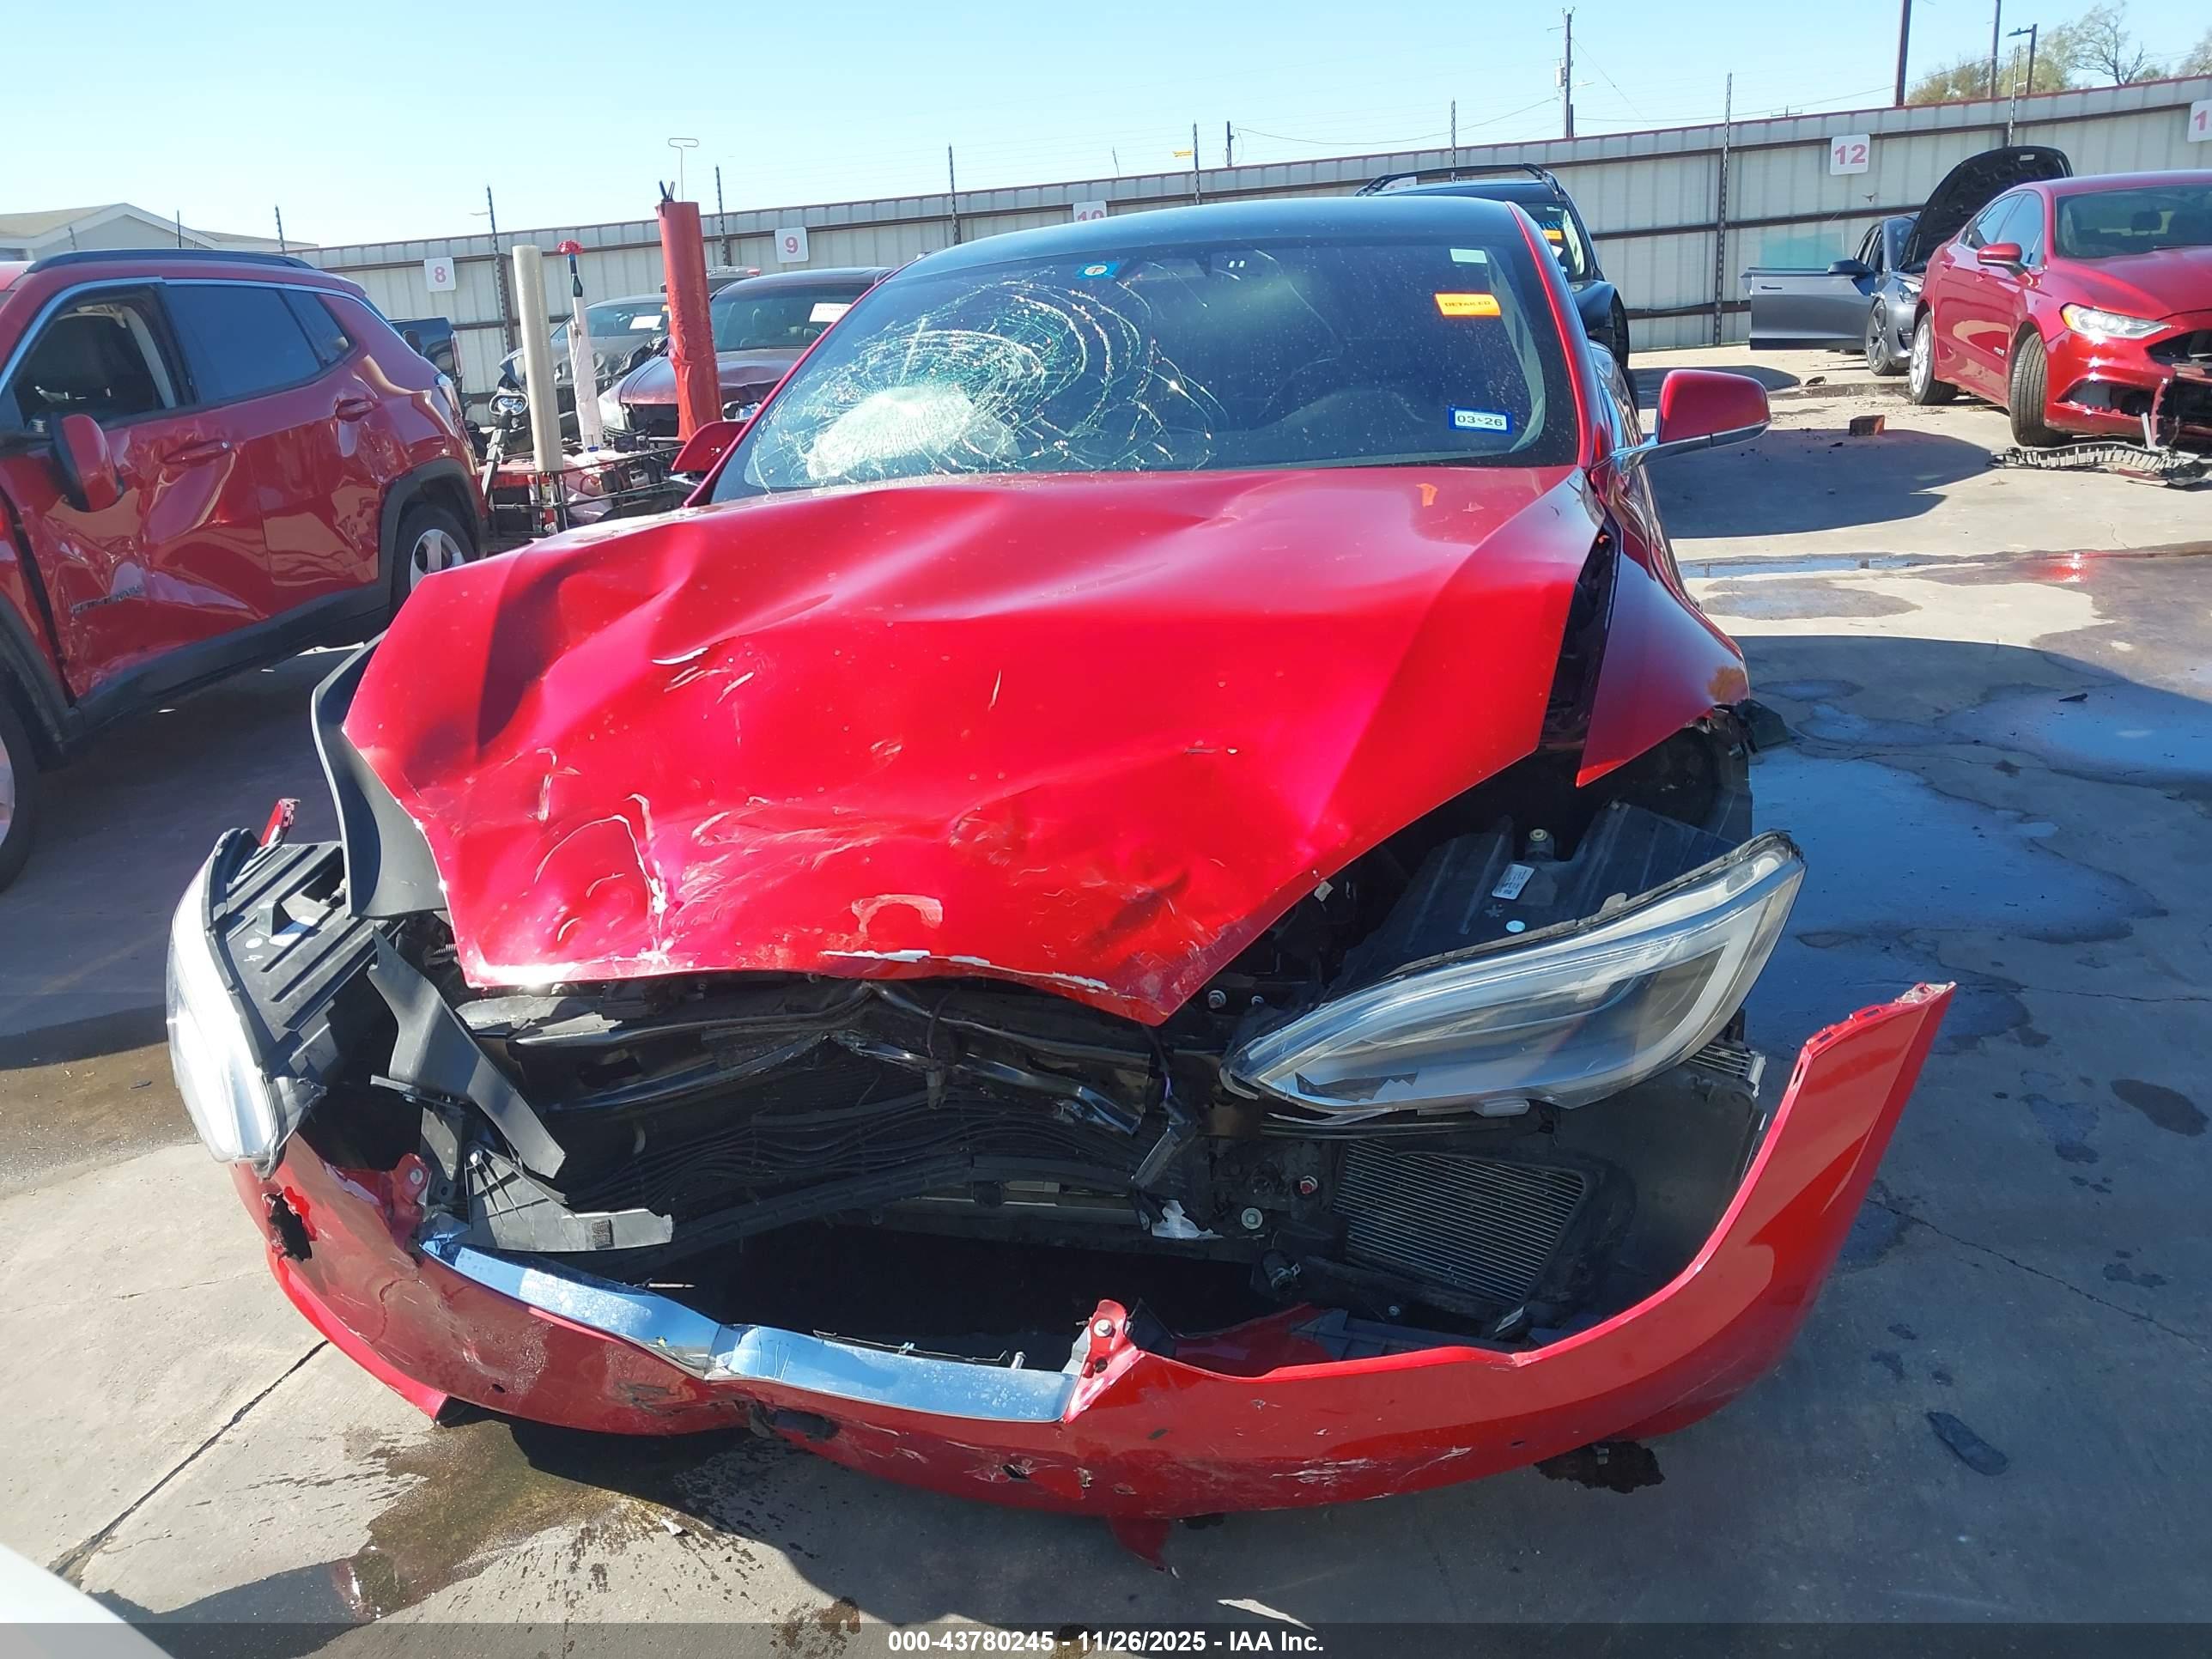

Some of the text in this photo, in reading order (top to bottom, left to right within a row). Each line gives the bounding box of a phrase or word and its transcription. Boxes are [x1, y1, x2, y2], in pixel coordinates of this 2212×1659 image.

[1834, 143, 1866, 165] 12
[785, 236, 799, 253] 9
[434, 266, 447, 283] 8
